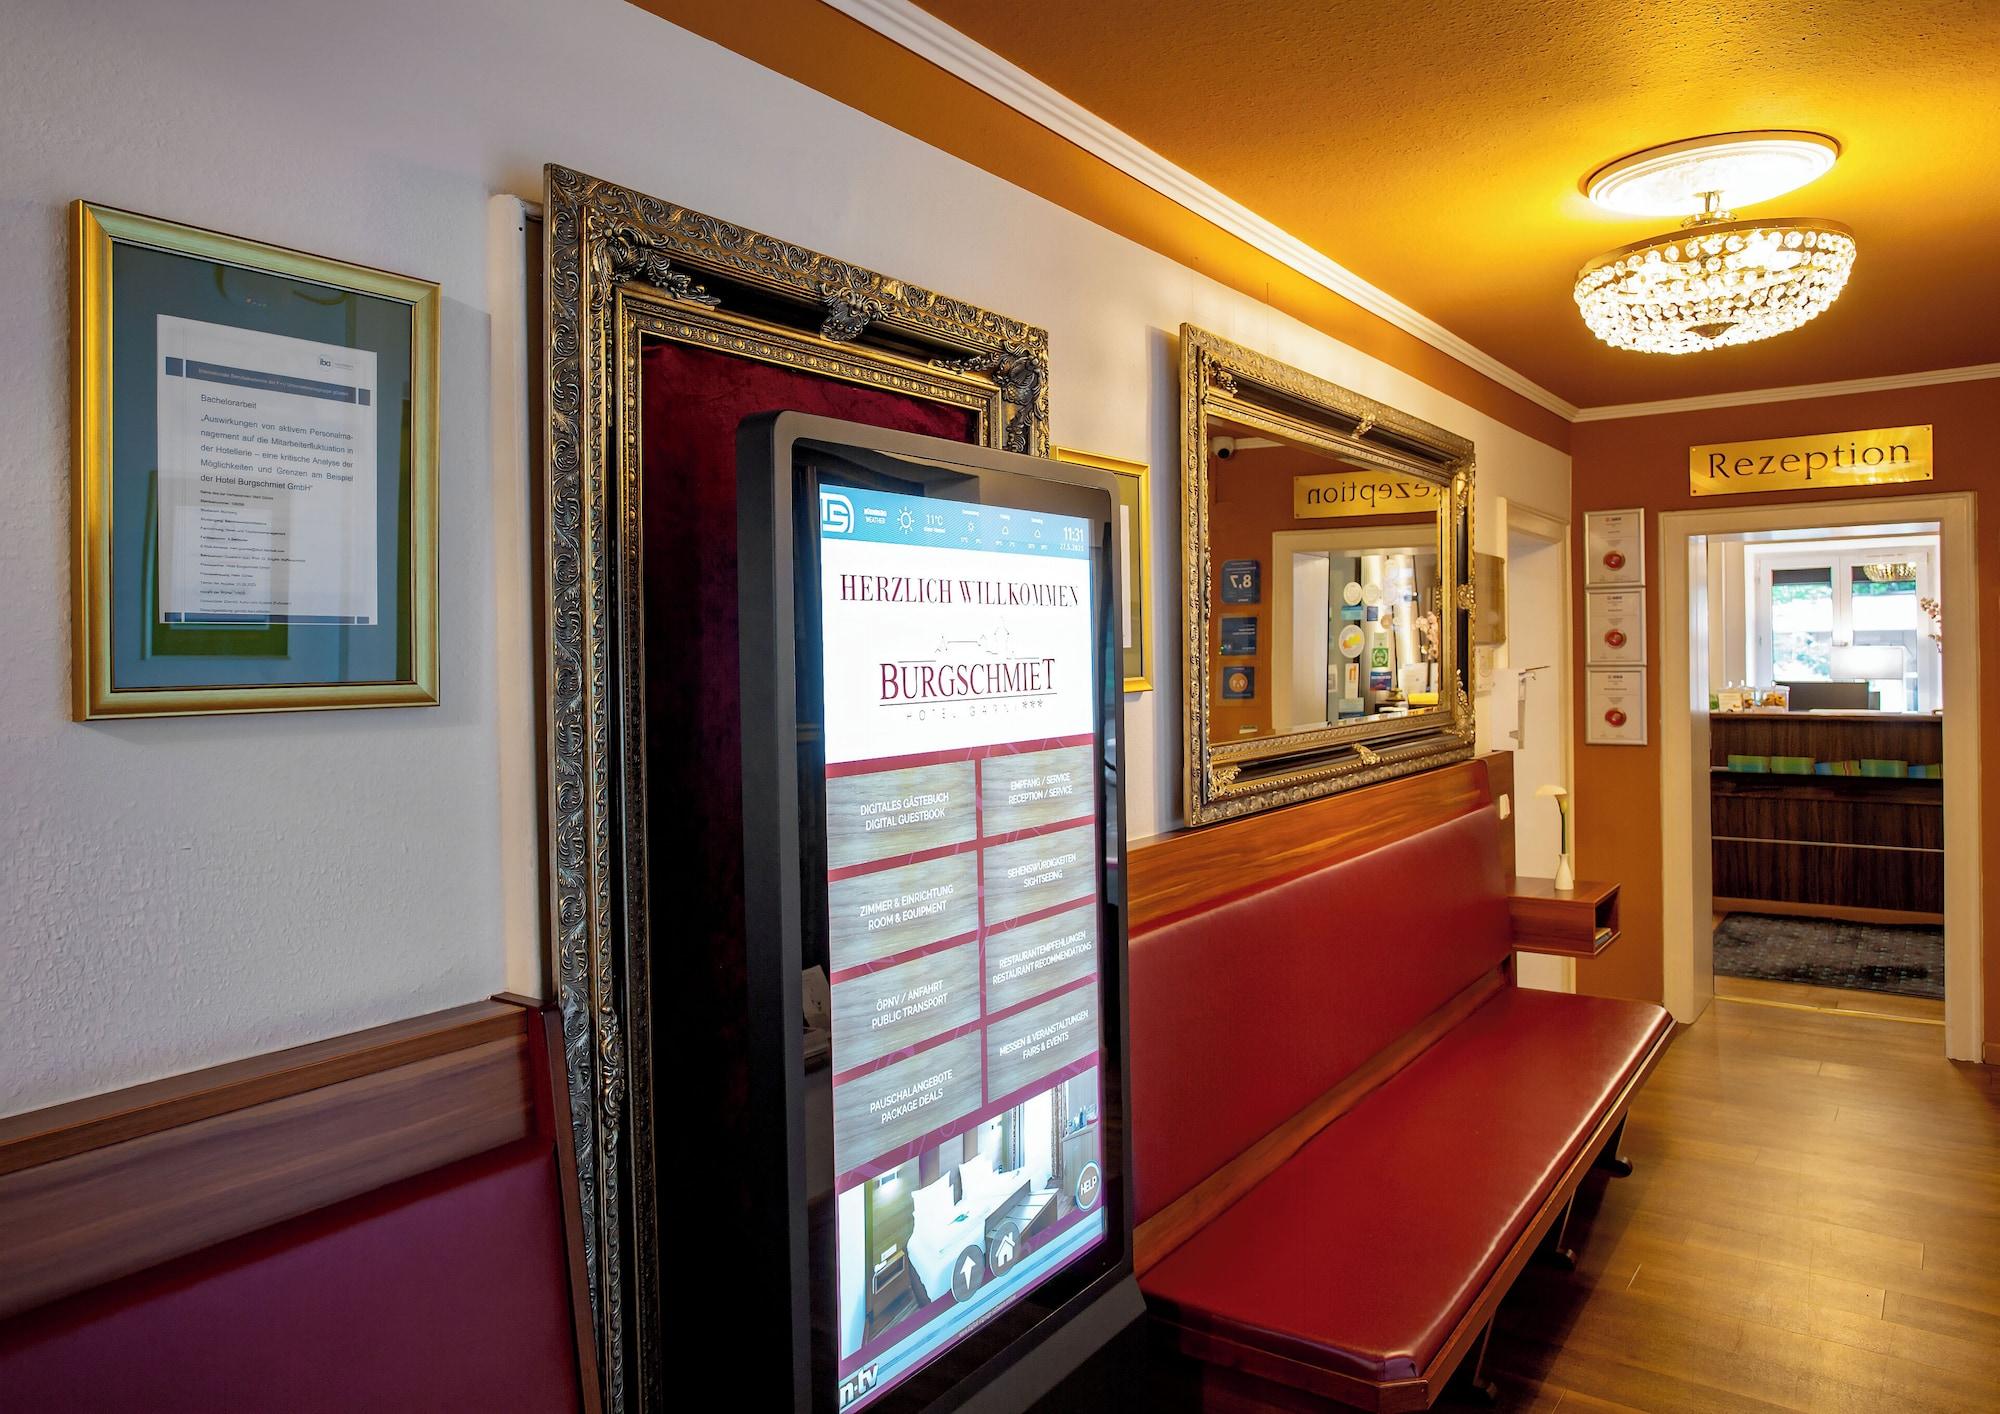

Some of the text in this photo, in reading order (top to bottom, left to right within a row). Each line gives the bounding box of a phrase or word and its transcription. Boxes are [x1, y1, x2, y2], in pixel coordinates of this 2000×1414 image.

[201, 394, 257, 409] Bachelorarbeit
[200, 430, 240, 440] nagement
[242, 434, 255, 442] auf
[257, 436, 268, 444] die
[271, 438, 345, 453] Mitarbeiterfluktuation
[278, 424, 307, 435] aktivem
[310, 428, 353, 440] Personalma-
[216, 446, 252, 456] Hotellerie
[262, 452, 278, 460] eine
[280, 453, 310, 463] kritische
[312, 457, 340, 467] Analyse
[1709, 442, 1912, 480] Rezeption
[200, 458, 254, 471] Möglichkeiten
[258, 466, 272, 474] und
[276, 467, 307, 477] Grenzen
[326, 473, 353, 482] Beispiel
[216, 475, 236, 484] Hotel
[238, 478, 286, 489] Burgschmiet
[926, 514, 944, 526] 11°C
[1063, 527, 1084, 542] 11:31
[840, 574, 1078, 607] HERZLICH WILLKOMMEN
[880, 658, 1056, 700] BURGSCHMIET
[1010, 778, 1041, 790] EMPFANG
[1046, 772, 1071, 785] SERVICE
[860, 792, 949, 816] DIGITALES GÄSTEBUCH
[1008, 791, 1044, 805] RECEPTION
[1049, 785, 1073, 798] SERVICE
[865, 808, 945, 831] DIGITAL GUESTBOOK
[1008, 852, 1076, 878] SEHENSWÜRDIGKEITEN
[1023, 870, 1063, 888] SIGHTSEEING
[860, 884, 954, 917] ZIMMER & EINRICHTUNG
[868, 900, 947, 930] ROOM & EQUIPMENT
[999, 930, 1086, 969] RESTAURANTEMPFEHLUNGEN
[992, 941, 1092, 985] RESTAURANT RECOMMENDATIONS
[876, 994, 900, 1012] ÖPNV
[908, 980, 944, 1000] ANFAHRT
[872, 992, 948, 1029] PUBLIC TRANSPORT
[999, 1038, 1026, 1056] MESSEN
[1031, 1009, 1089, 1042] VERANSTALTUNGEN
[1022, 1045, 1040, 1060] FAIRS
[1046, 1031, 1069, 1049] EVENTS
[870, 1069, 953, 1114] PAUSCHALANGEBOTE
[881, 1088, 944, 1124] PACKAGE DEALS
[1080, 1176, 1097, 1196] HELP
